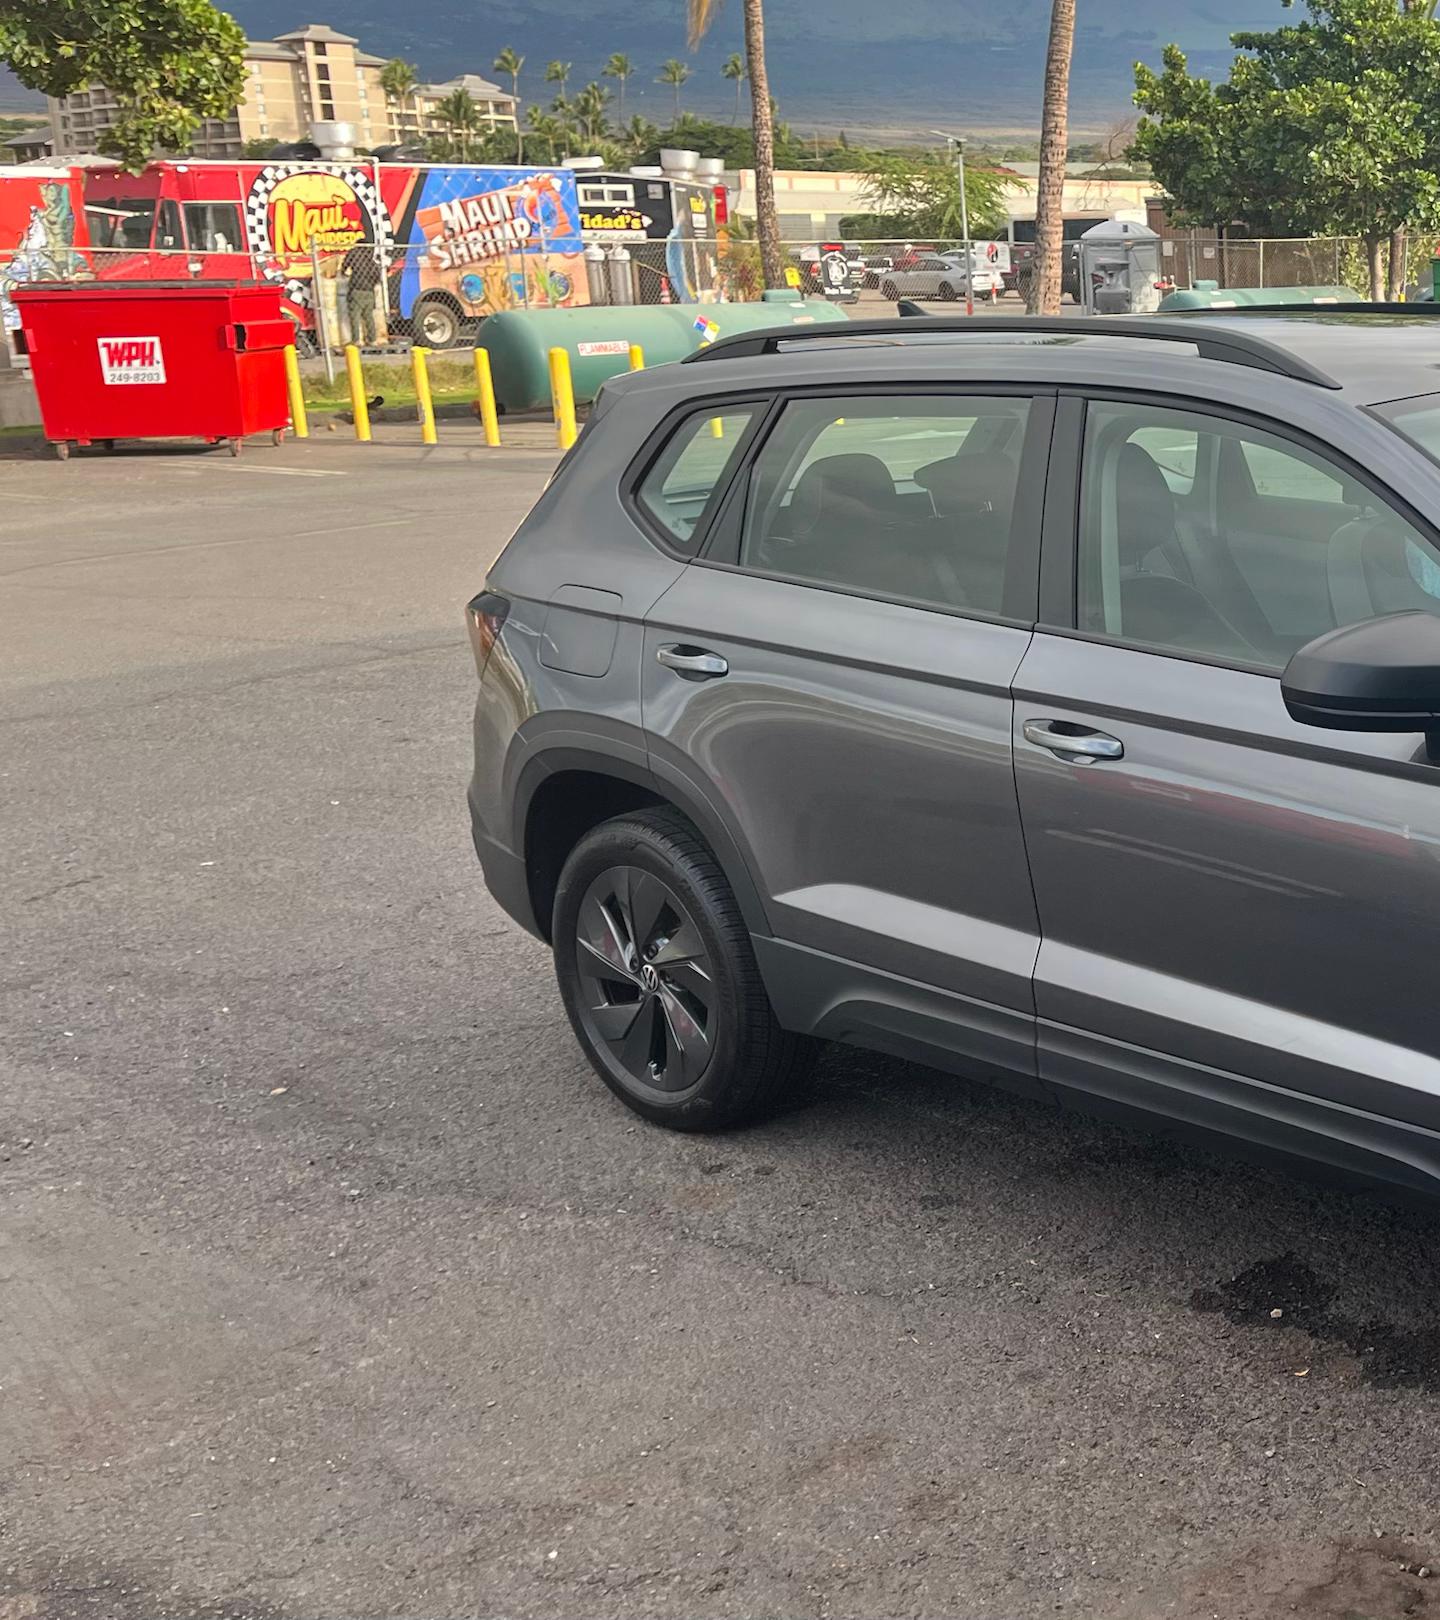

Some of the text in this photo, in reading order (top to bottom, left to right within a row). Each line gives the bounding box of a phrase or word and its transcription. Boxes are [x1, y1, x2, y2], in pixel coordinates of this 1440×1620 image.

[275, 194, 349, 270] Maui
[439, 191, 514, 238] MAUI
[430, 217, 531, 270] SHRIMP
[102, 342, 155, 367] WPH
